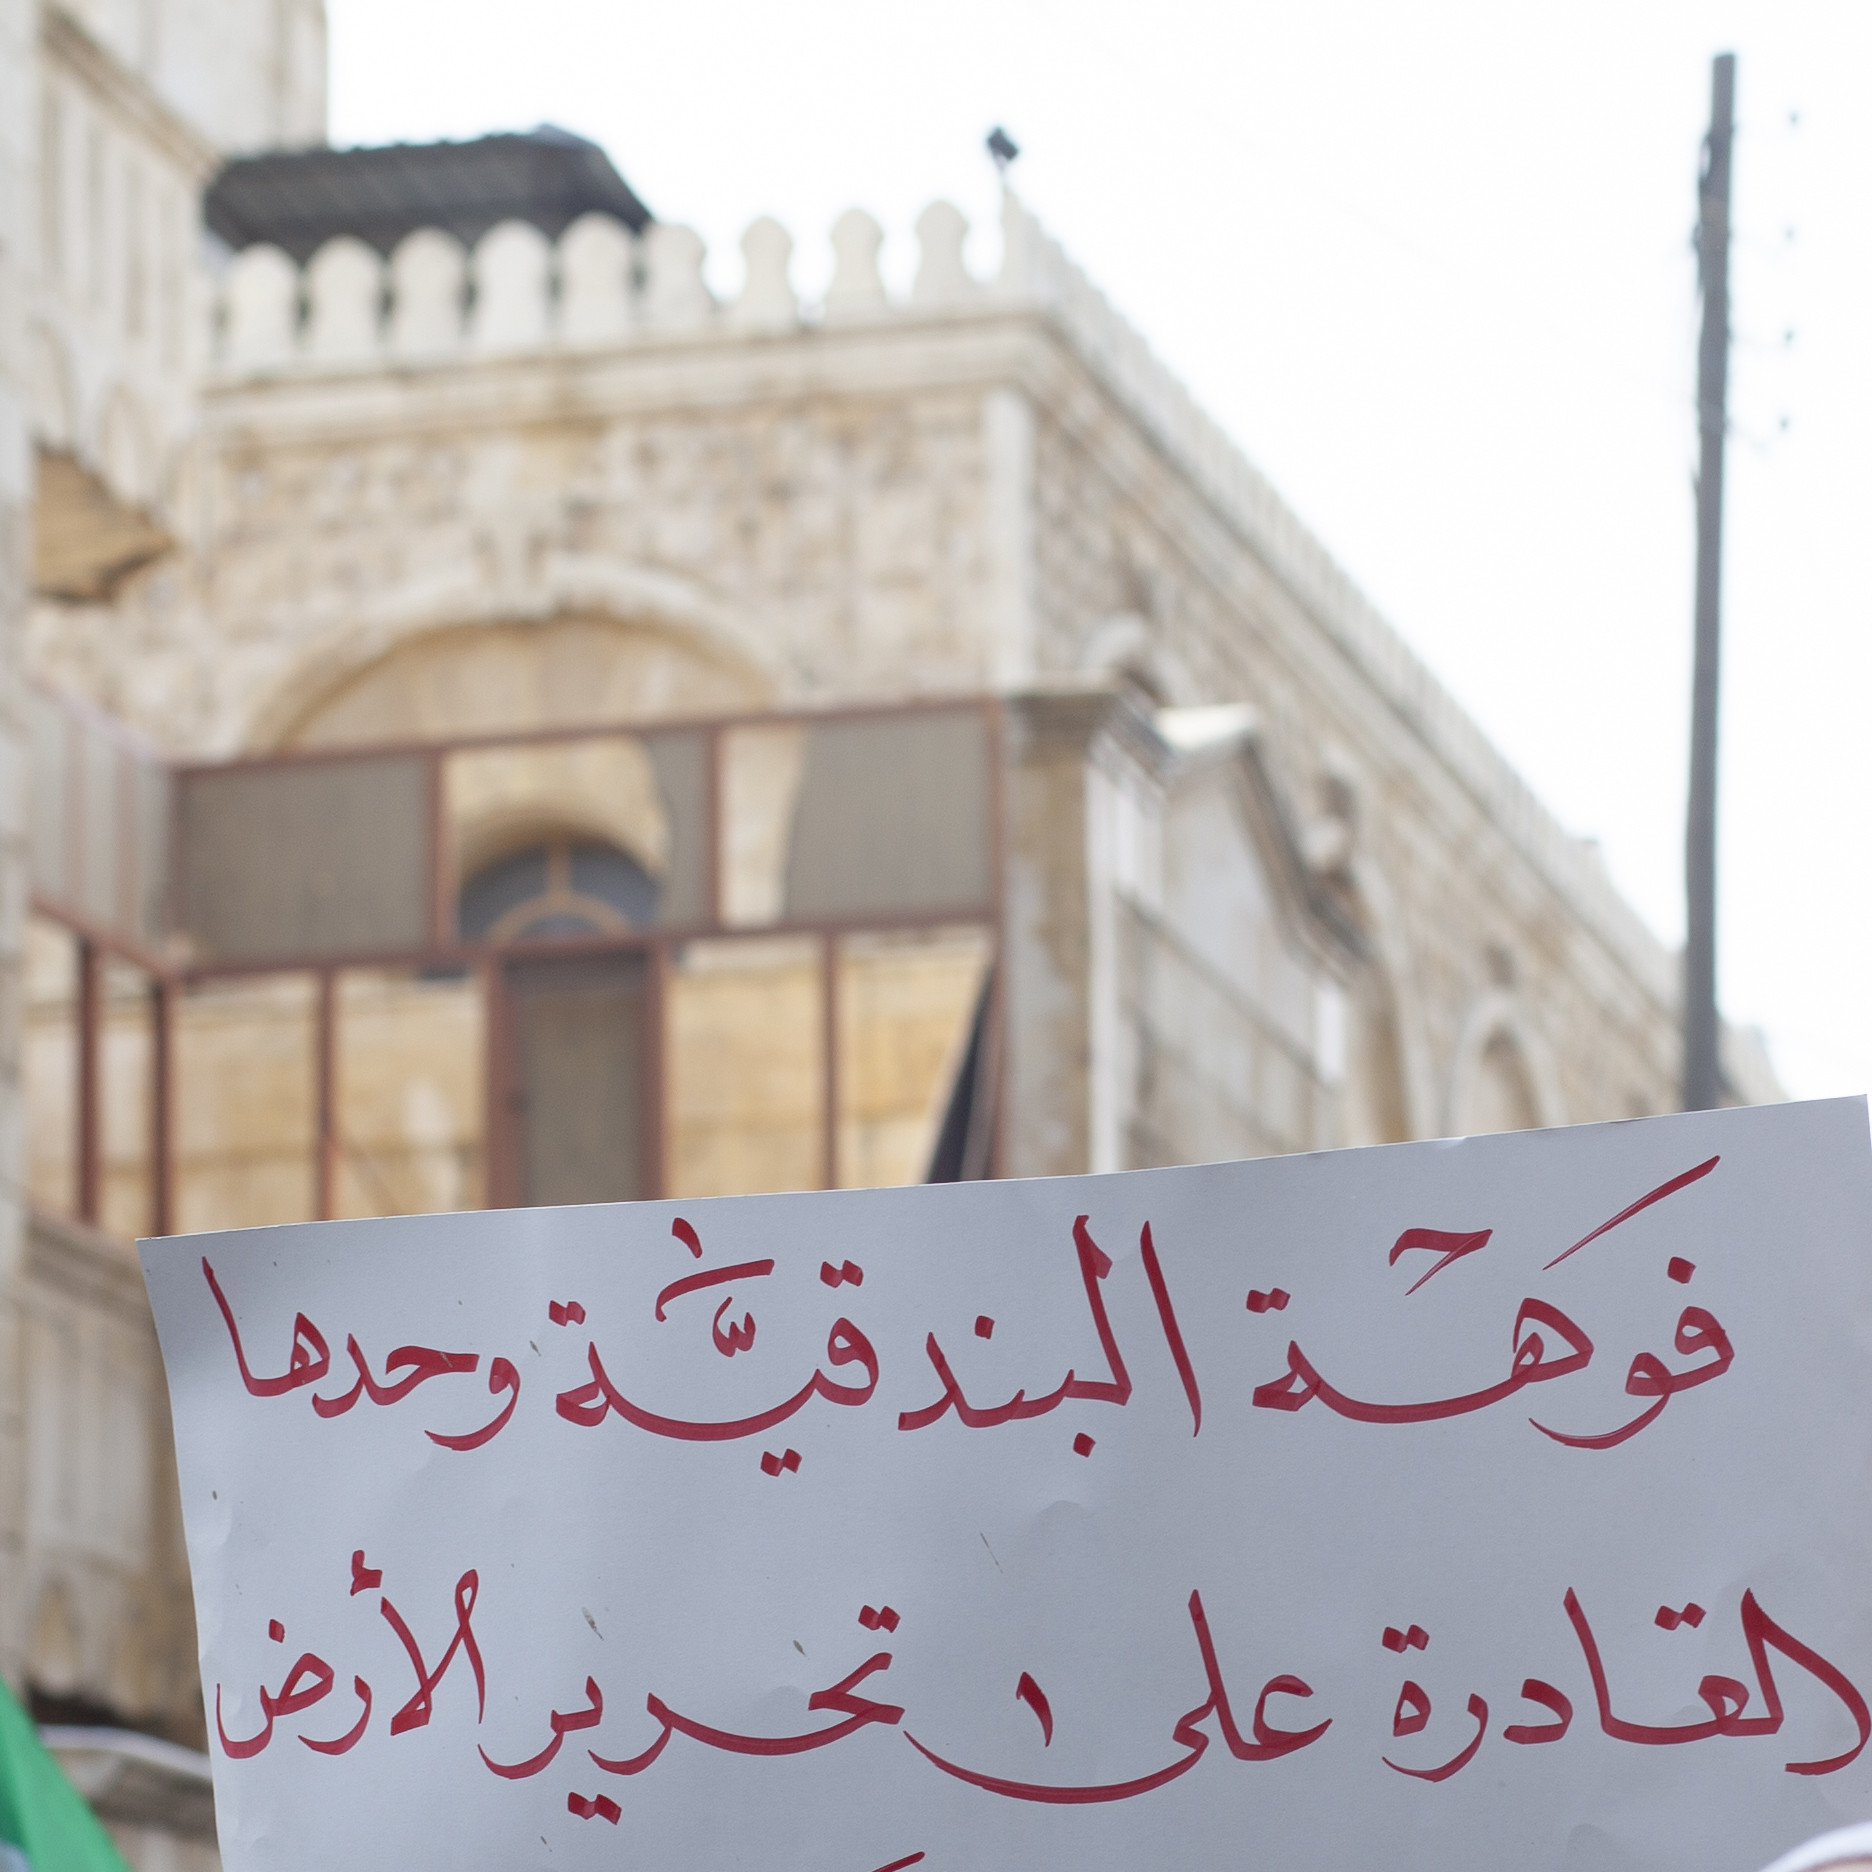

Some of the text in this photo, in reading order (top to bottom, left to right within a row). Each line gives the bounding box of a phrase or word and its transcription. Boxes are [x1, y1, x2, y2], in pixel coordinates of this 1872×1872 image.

[203, 1256, 521, 1452] وحدها
[217, 1550, 1872, 1826] القادرة على تحرير الأرض
